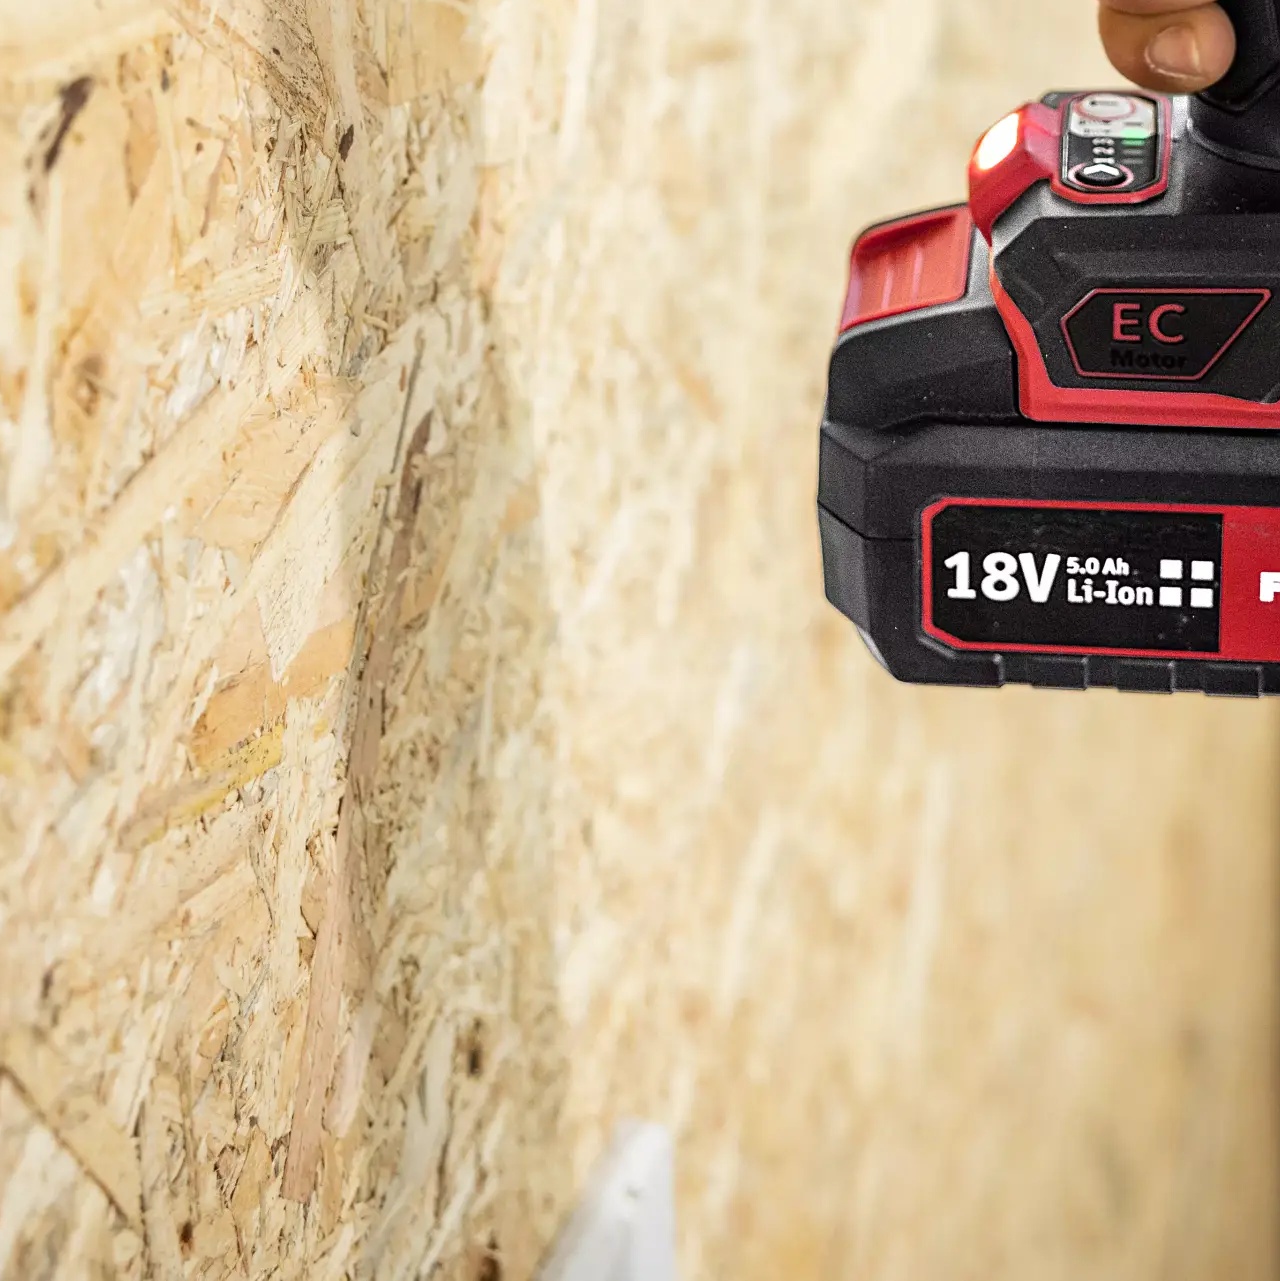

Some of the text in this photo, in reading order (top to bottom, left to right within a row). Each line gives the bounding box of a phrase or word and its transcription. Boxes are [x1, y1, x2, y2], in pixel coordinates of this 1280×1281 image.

[1112, 302, 1185, 343] EC
[1110, 349, 1188, 370] Motor
[944, 551, 1061, 603] 18V
[1066, 557, 1130, 576] 5.0 Ah
[1067, 578, 1154, 606] Li-Ion
